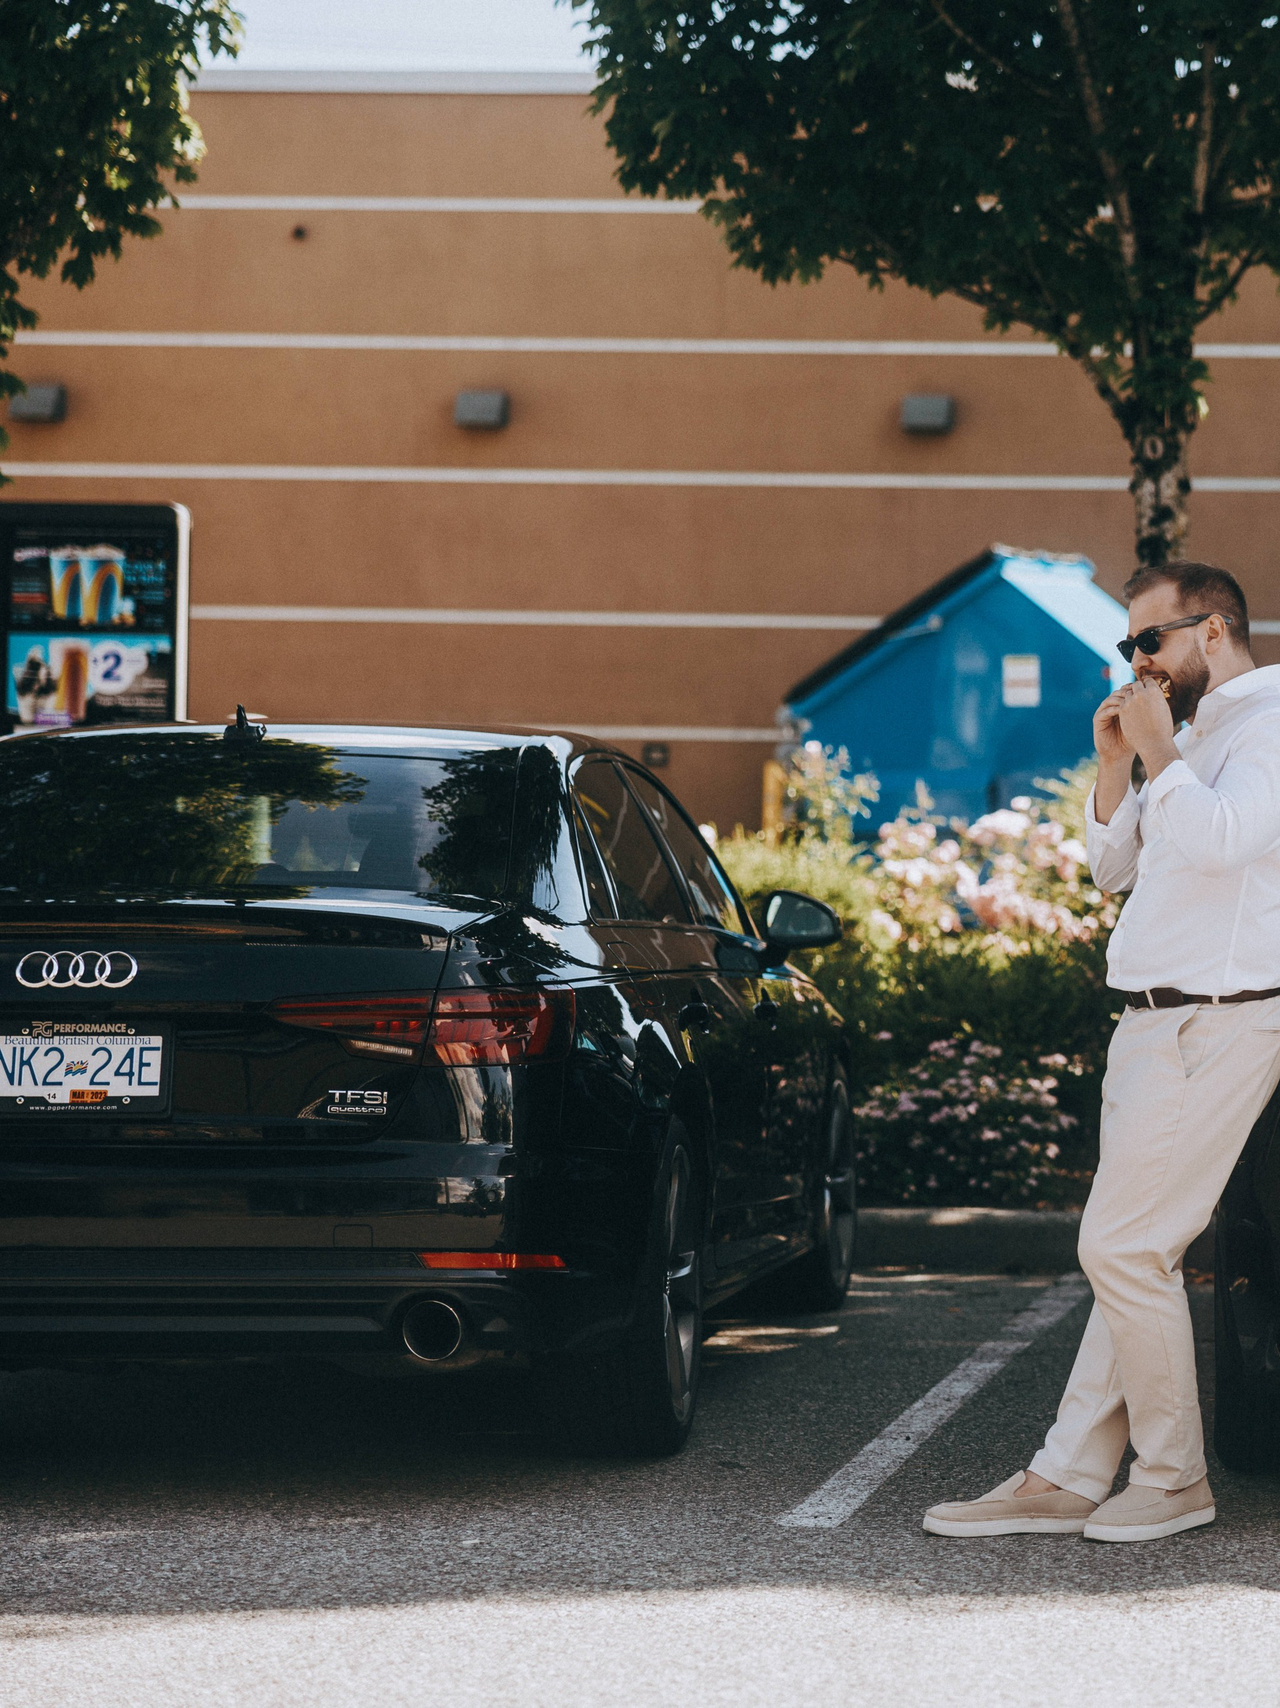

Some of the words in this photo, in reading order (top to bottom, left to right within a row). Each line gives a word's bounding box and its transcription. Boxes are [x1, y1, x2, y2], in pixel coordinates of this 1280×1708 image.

[53, 1023, 127, 1033] PERFORMANCE
[58, 1036, 94, 1045] British
[96, 1036, 152, 1045] Columbia
[71, 1091, 85, 1099] MAR
[328, 1090, 388, 1105] TFSI
[330, 1106, 384, 1114] quattro
